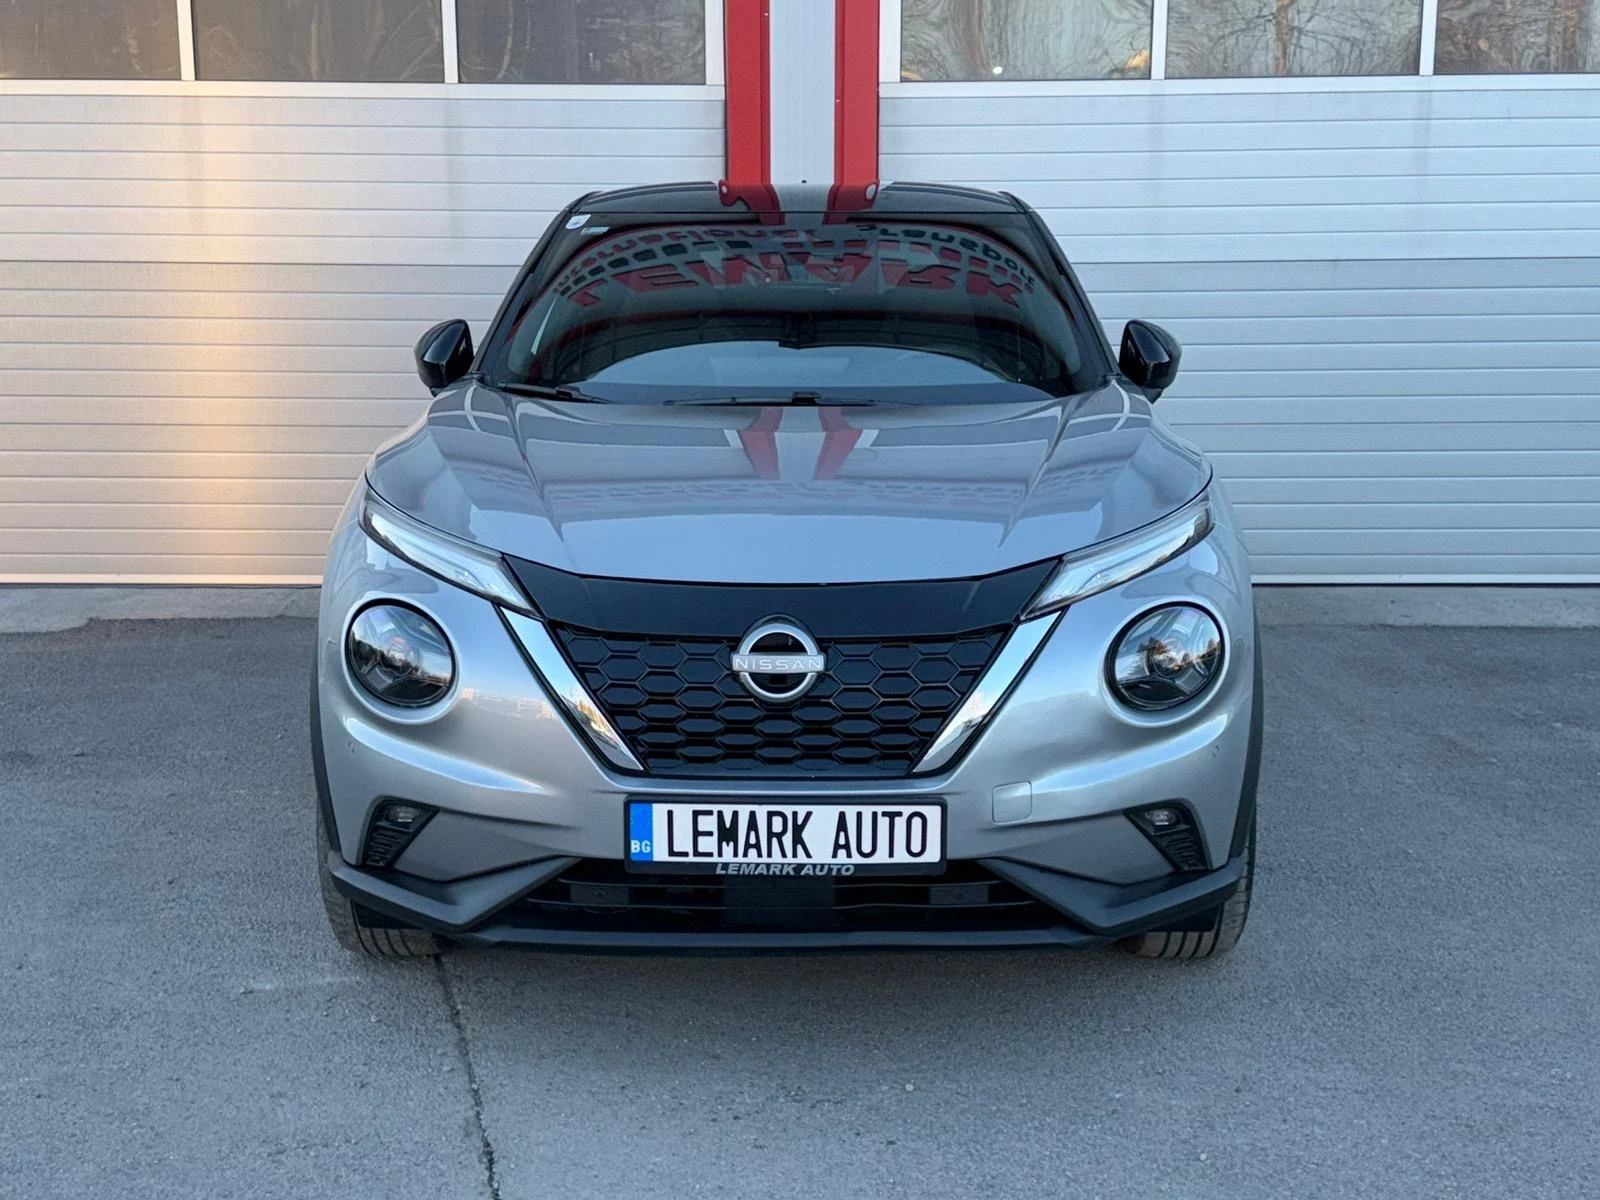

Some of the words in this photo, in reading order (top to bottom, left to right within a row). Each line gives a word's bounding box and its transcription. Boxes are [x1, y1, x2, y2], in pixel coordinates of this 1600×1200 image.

[735, 658, 821, 671] NISSAN
[667, 809, 813, 859] LEMARK
[831, 810, 928, 859] AUTO
[630, 839, 652, 853] BG
[715, 863, 797, 875] LEMARK
[800, 864, 855, 876] AUTO
